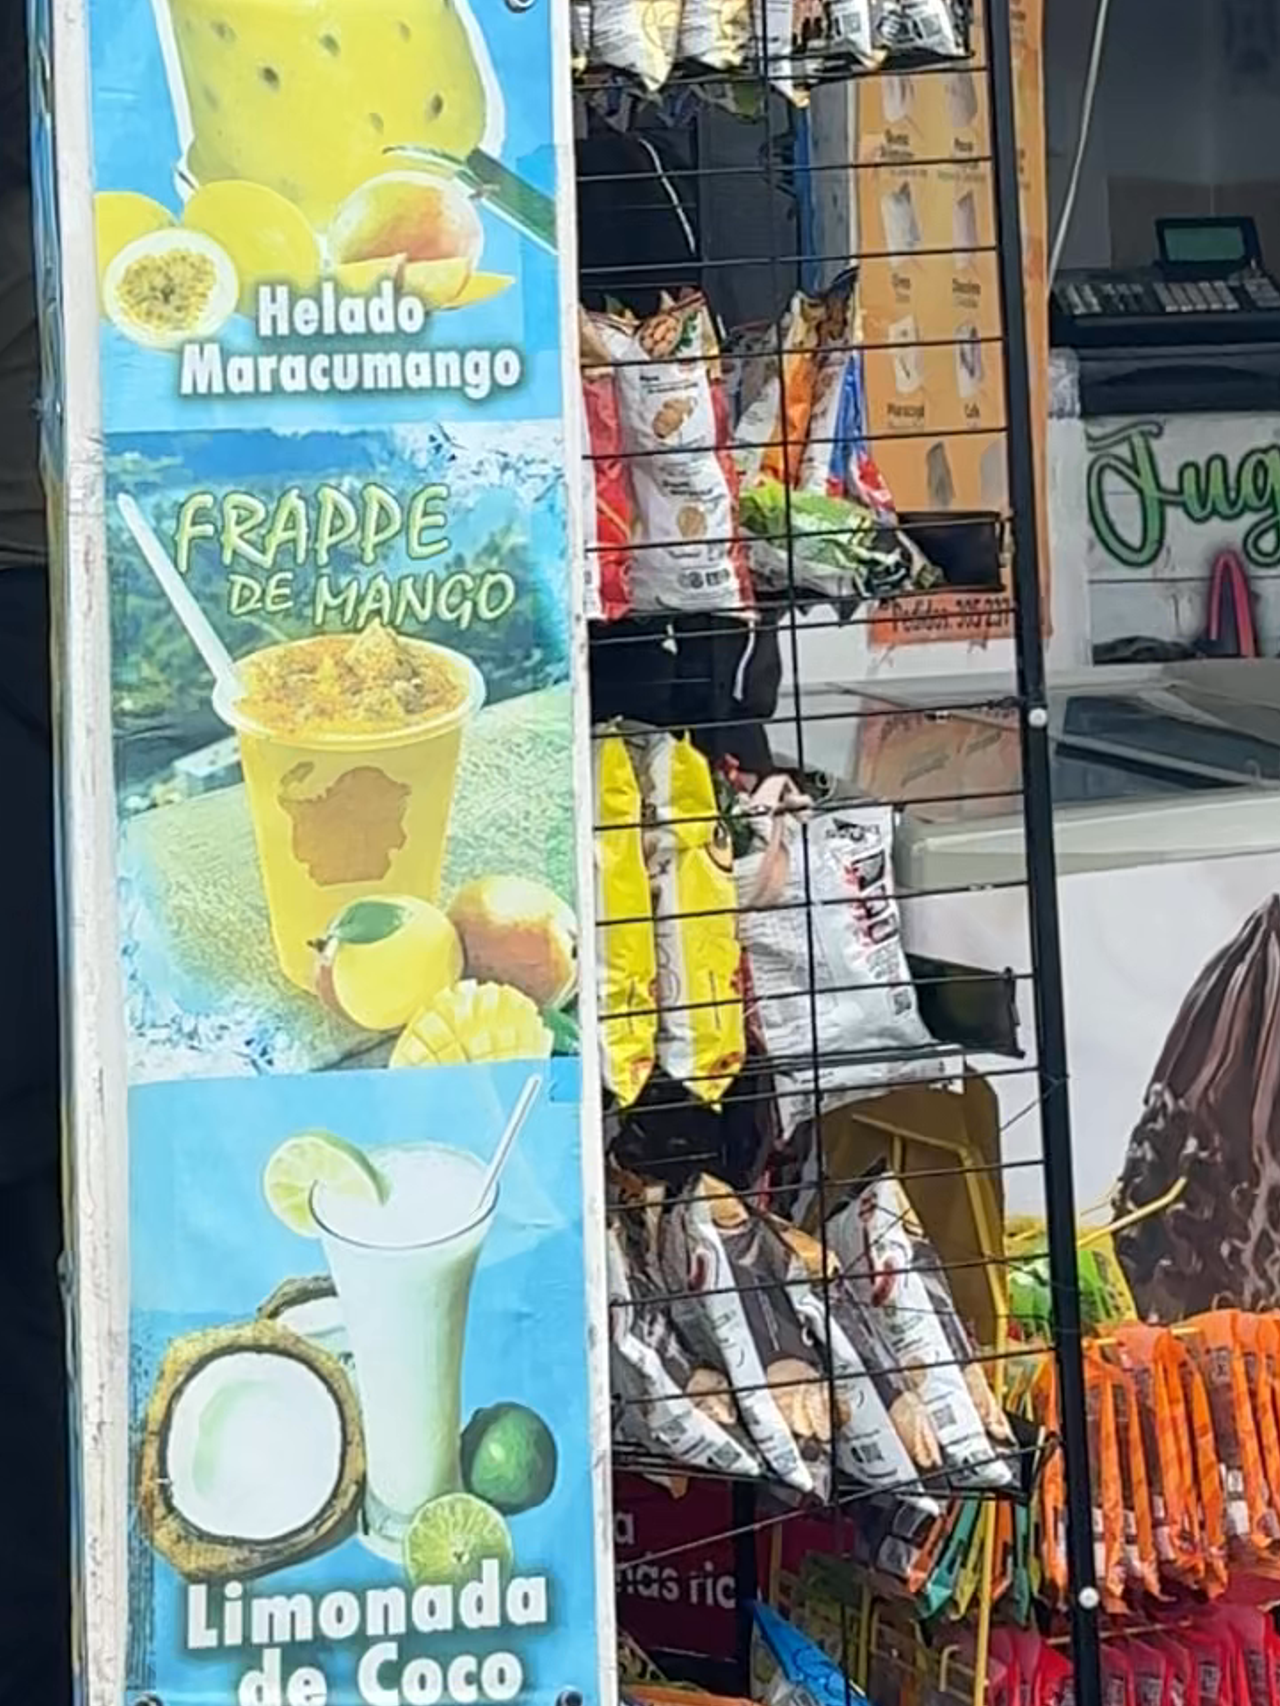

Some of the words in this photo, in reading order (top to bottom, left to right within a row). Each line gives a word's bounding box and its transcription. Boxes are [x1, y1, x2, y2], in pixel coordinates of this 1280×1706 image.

[257, 280, 426, 337] Helado
[179, 342, 522, 401] Maracumango
[173, 482, 451, 574] FRAPPE
[228, 572, 296, 617] DE
[312, 571, 517, 631] MANGO
[185, 1557, 549, 1650] Limonada
[689, 1560, 736, 1610] ric
